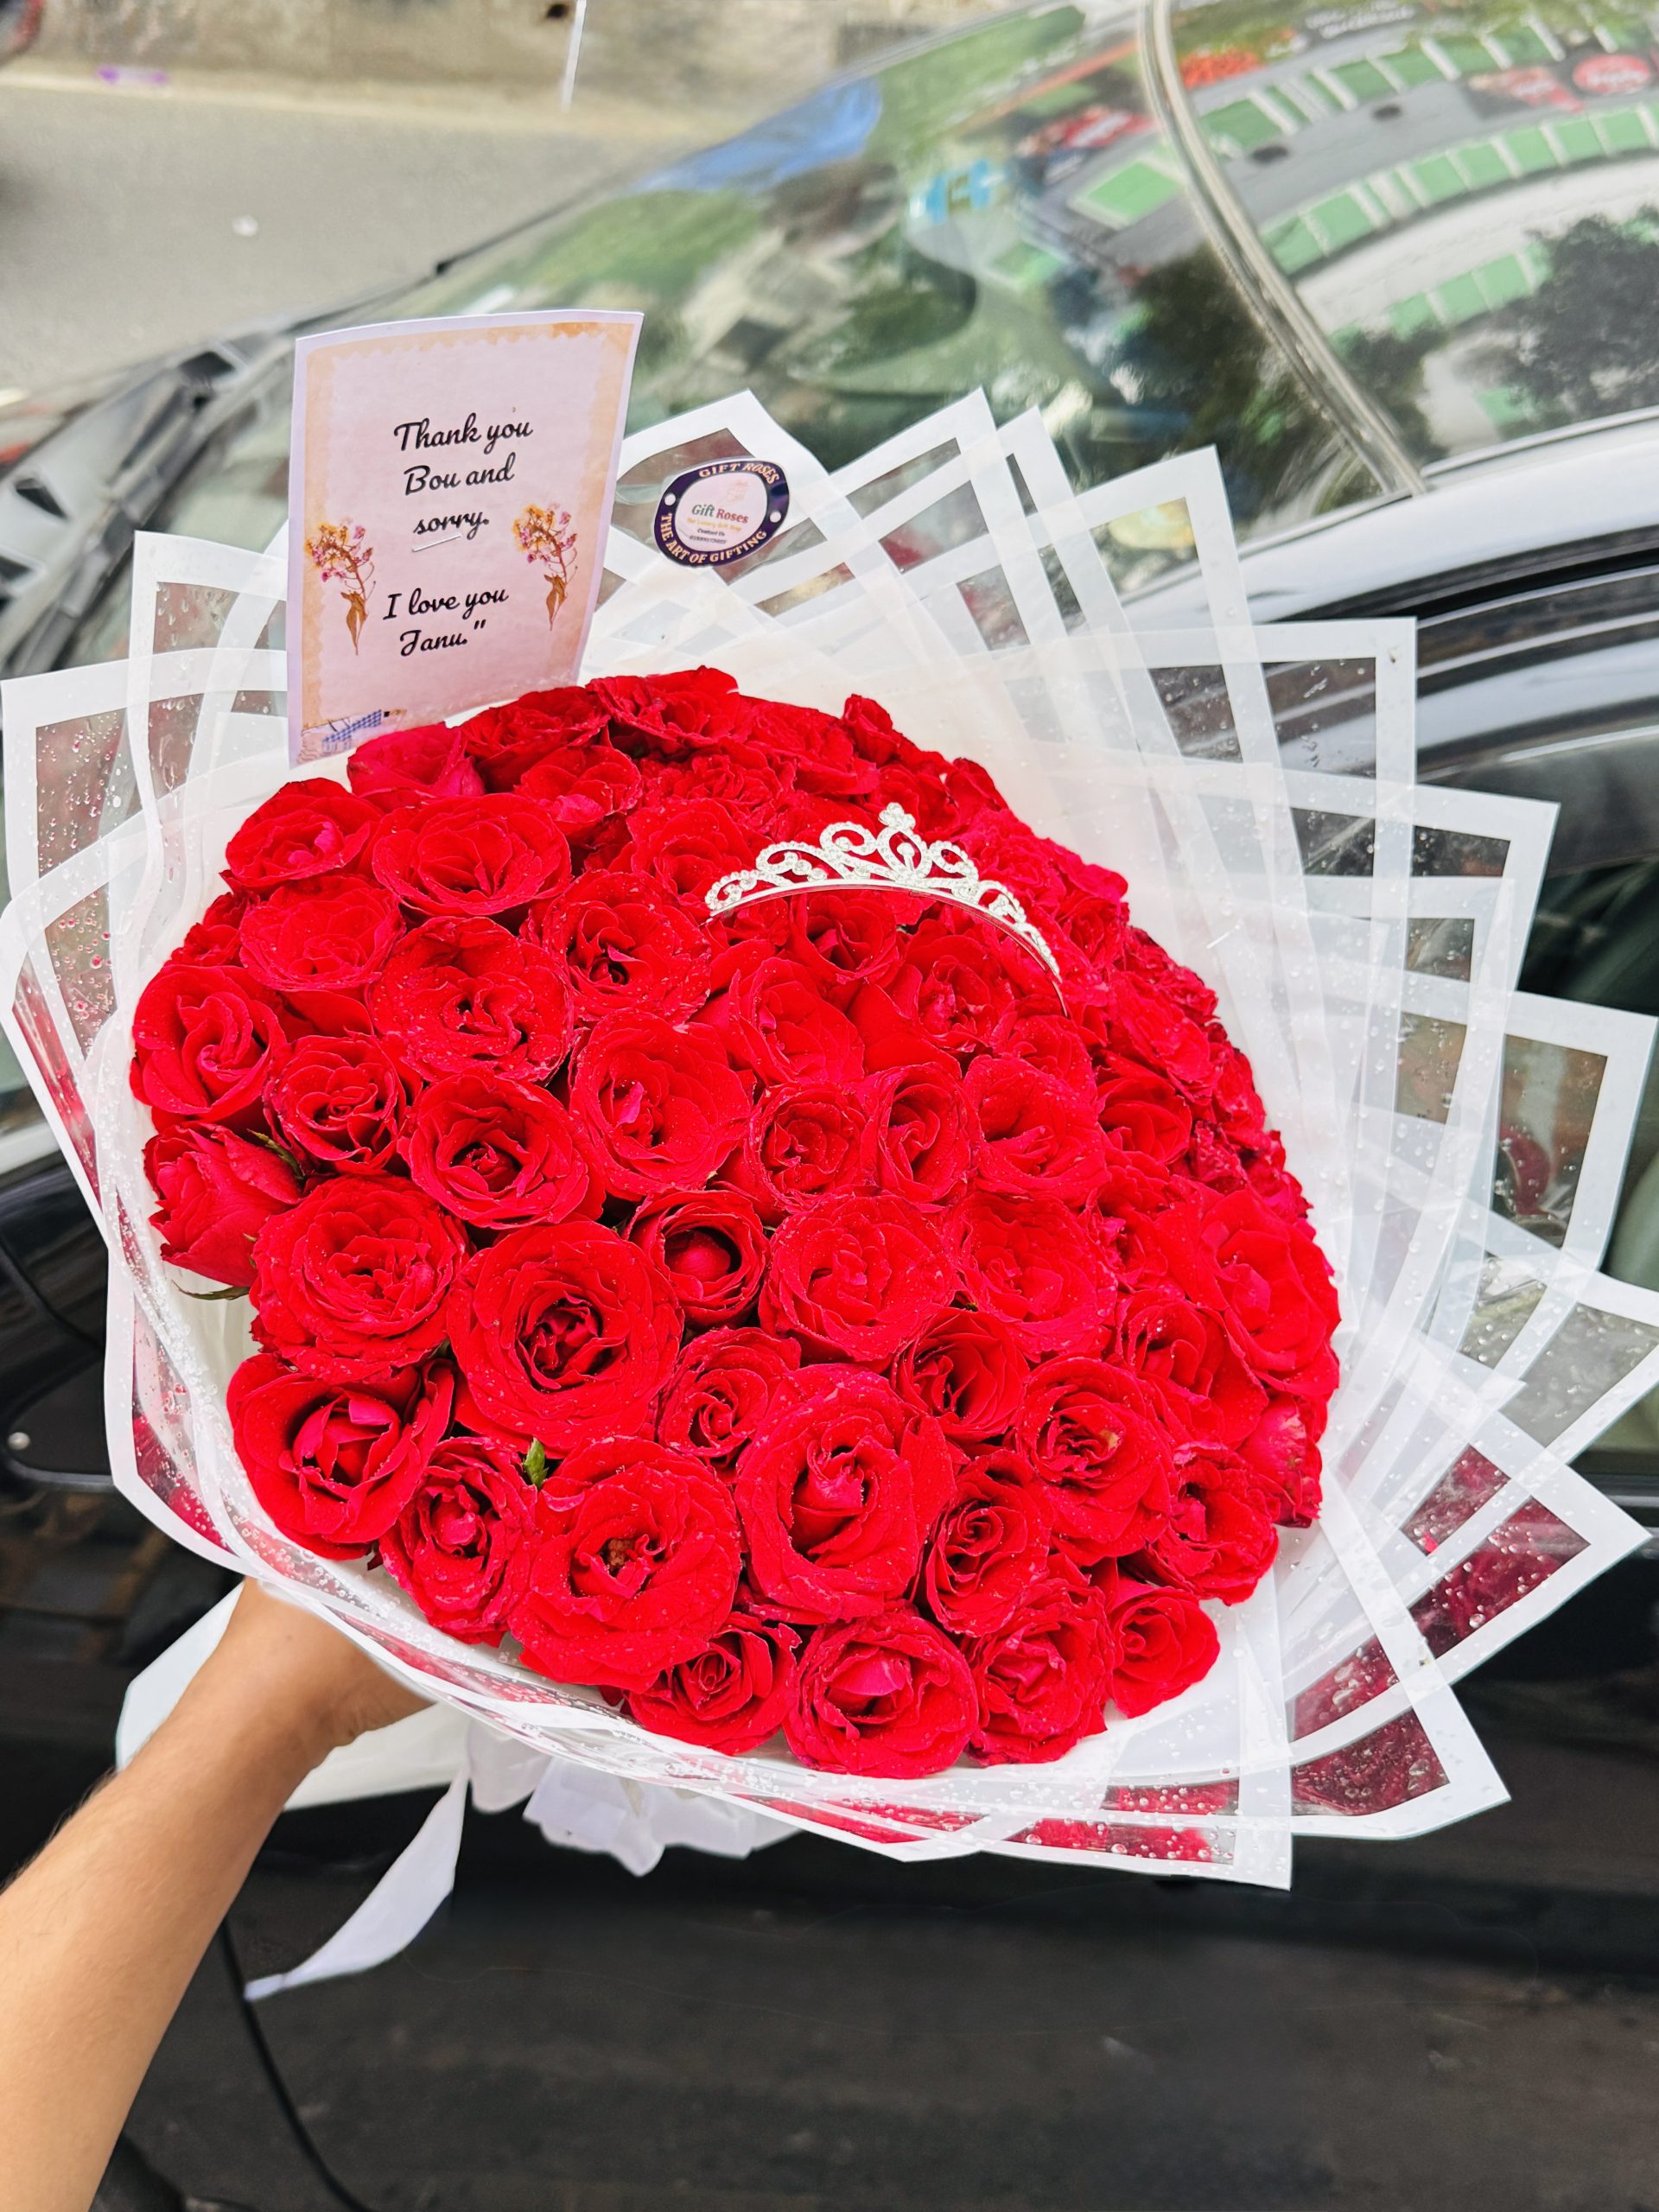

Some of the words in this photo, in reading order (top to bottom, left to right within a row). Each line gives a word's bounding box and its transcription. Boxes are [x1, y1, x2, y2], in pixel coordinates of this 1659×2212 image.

[394, 412, 481, 451] Thank
[484, 422, 533, 454] you
[404, 464, 461, 496] Bou
[465, 452, 516, 485] and
[699, 462, 741, 478] GIFT
[743, 462, 780, 485] ROSES
[413, 512, 490, 541] sorry.
[692, 504, 715, 517] Gift
[716, 508, 748, 524] Roses
[661, 512, 673, 541] THE
[667, 542, 690, 559] ART
[690, 553, 708, 563] OF
[709, 531, 767, 563] GIFTING
[382, 593, 402, 620] I
[408, 588, 460, 616] love
[461, 588, 509, 620] you
